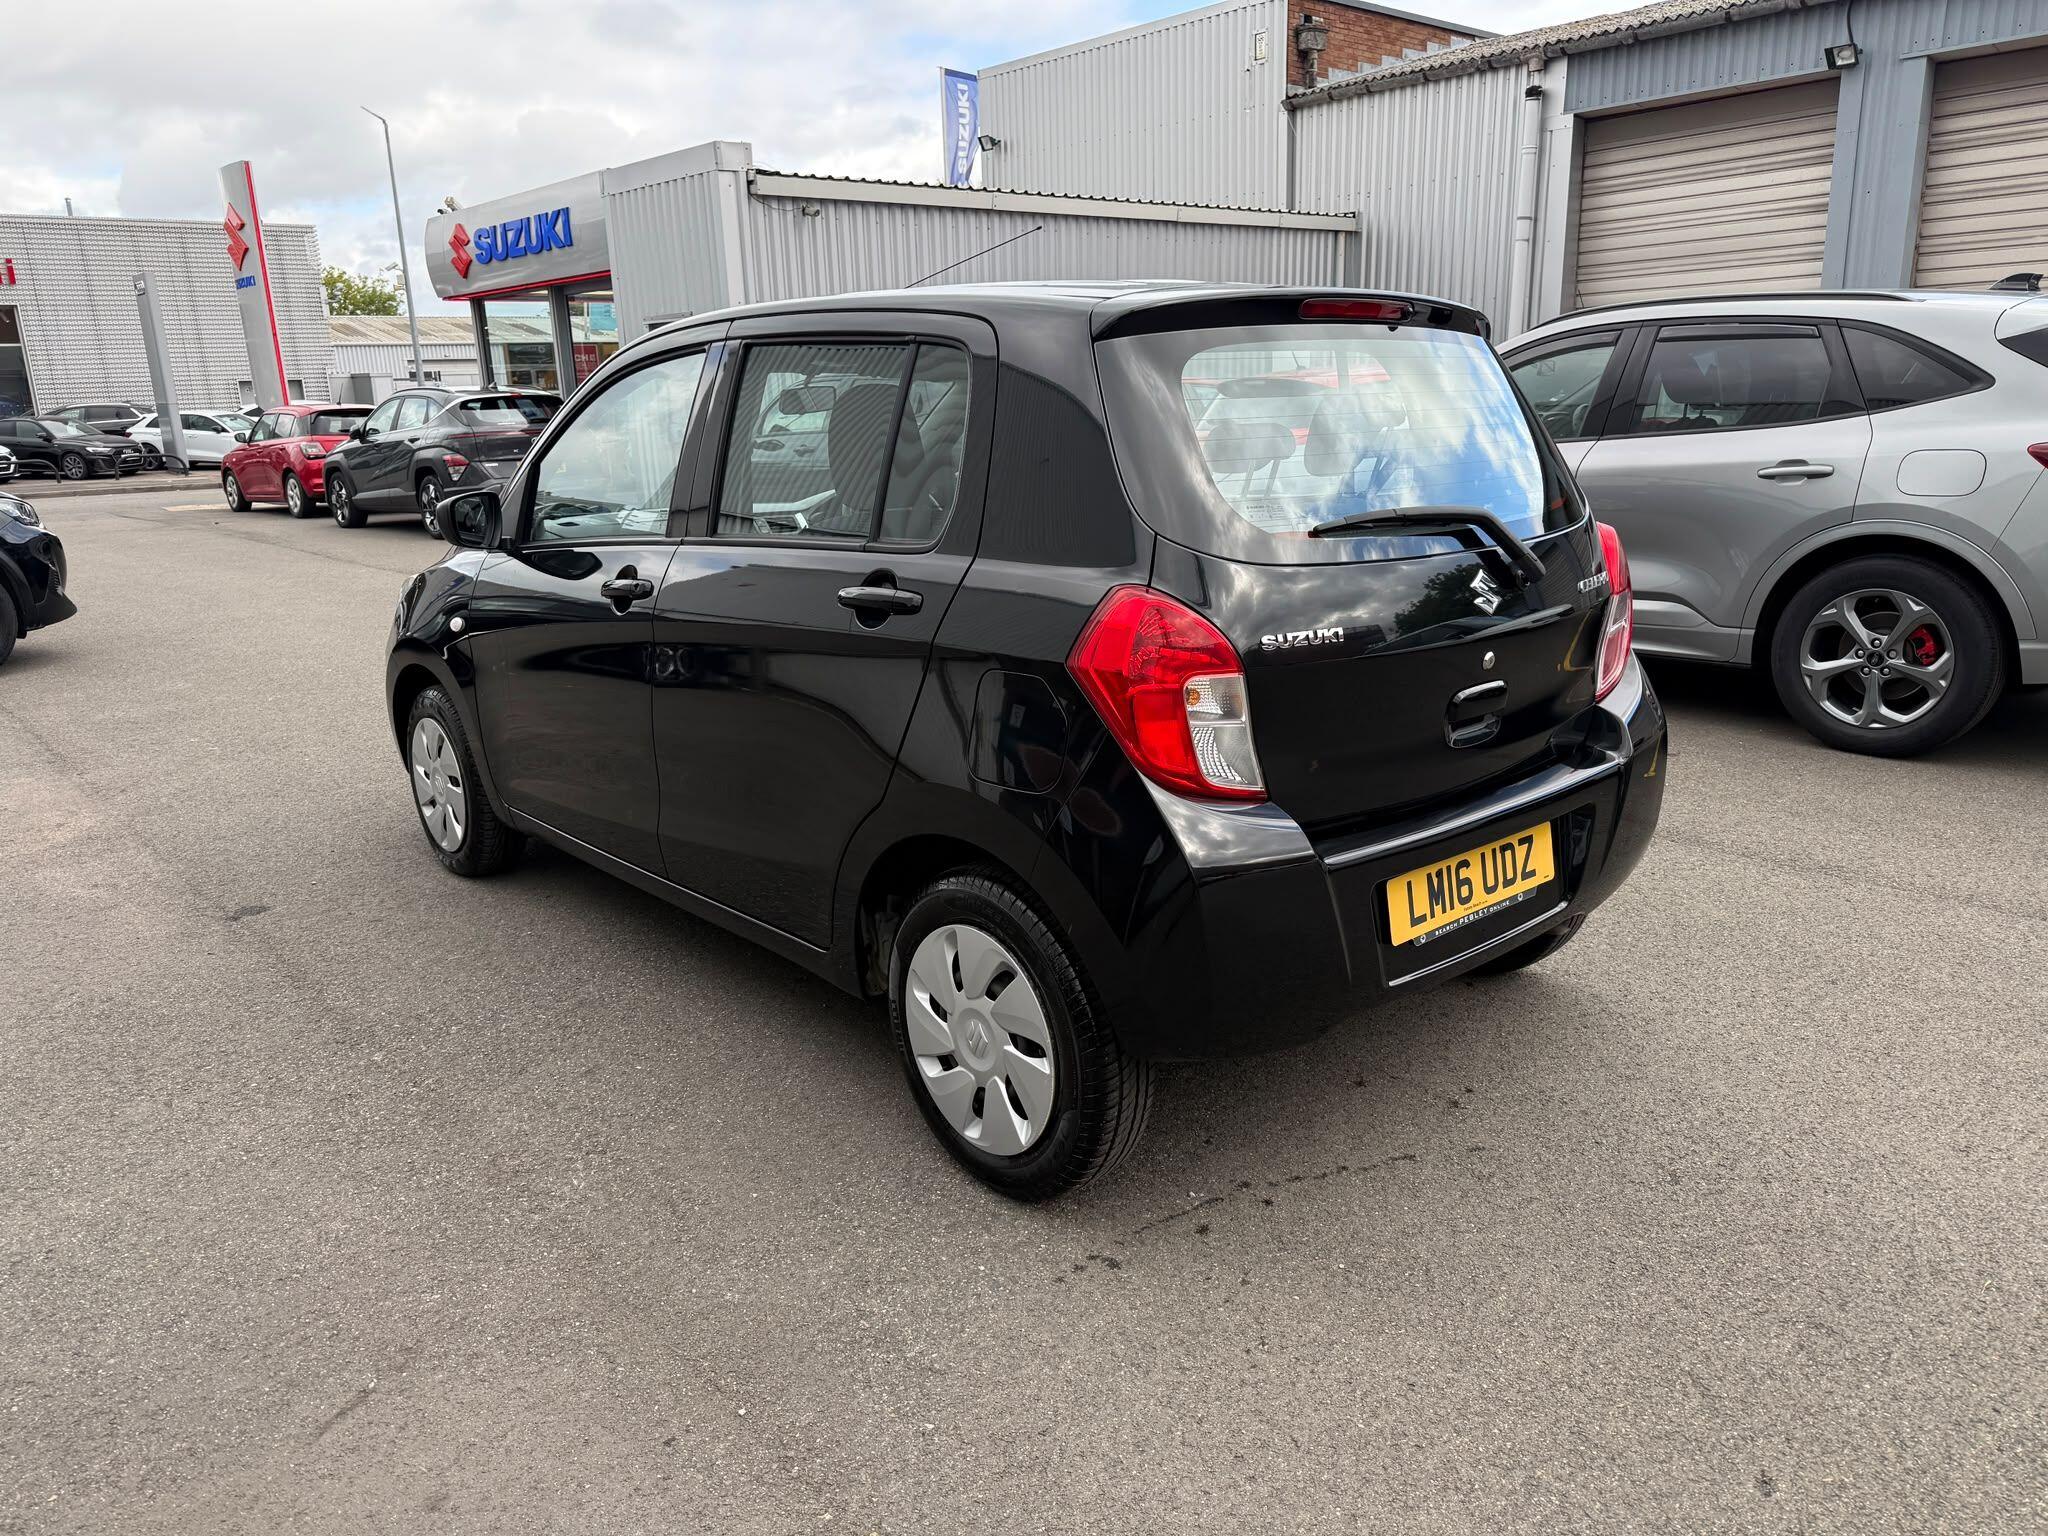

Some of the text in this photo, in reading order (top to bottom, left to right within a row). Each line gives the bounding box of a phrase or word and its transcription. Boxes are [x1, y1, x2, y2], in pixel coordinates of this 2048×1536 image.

[957, 83, 970, 175] SUZUKI
[473, 206, 573, 265] SUZUKI
[1260, 627, 1344, 651] SUZUKI
[1406, 834, 1537, 928] LM16 UDZ
[1489, 900, 1510, 912] ONLINE
